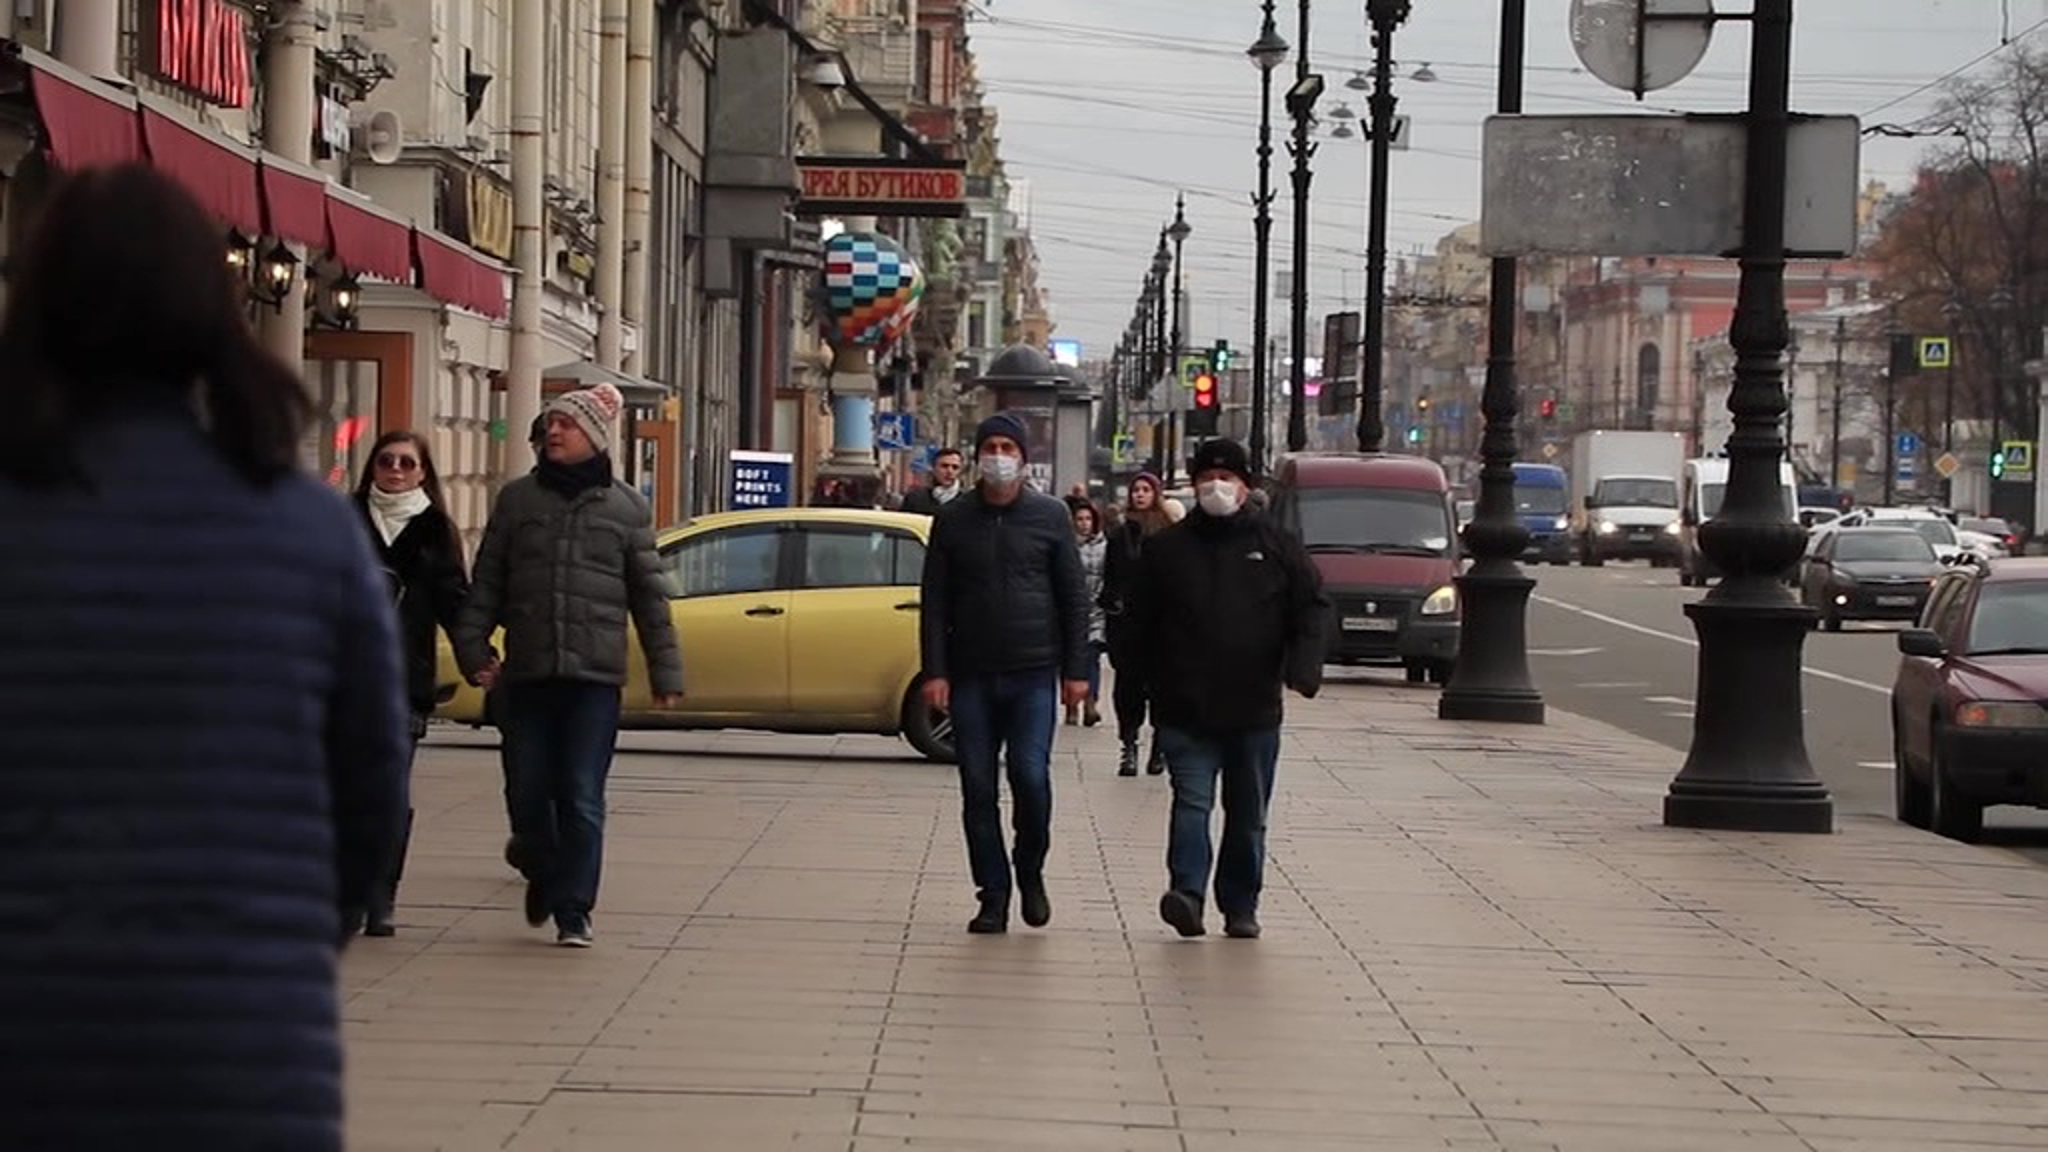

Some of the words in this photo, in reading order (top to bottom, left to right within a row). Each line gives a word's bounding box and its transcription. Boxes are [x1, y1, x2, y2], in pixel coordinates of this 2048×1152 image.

[855, 171, 958, 199] БУТИКОВ
[735, 481, 781, 493] PRINTS
[735, 494, 768, 505] HERE
